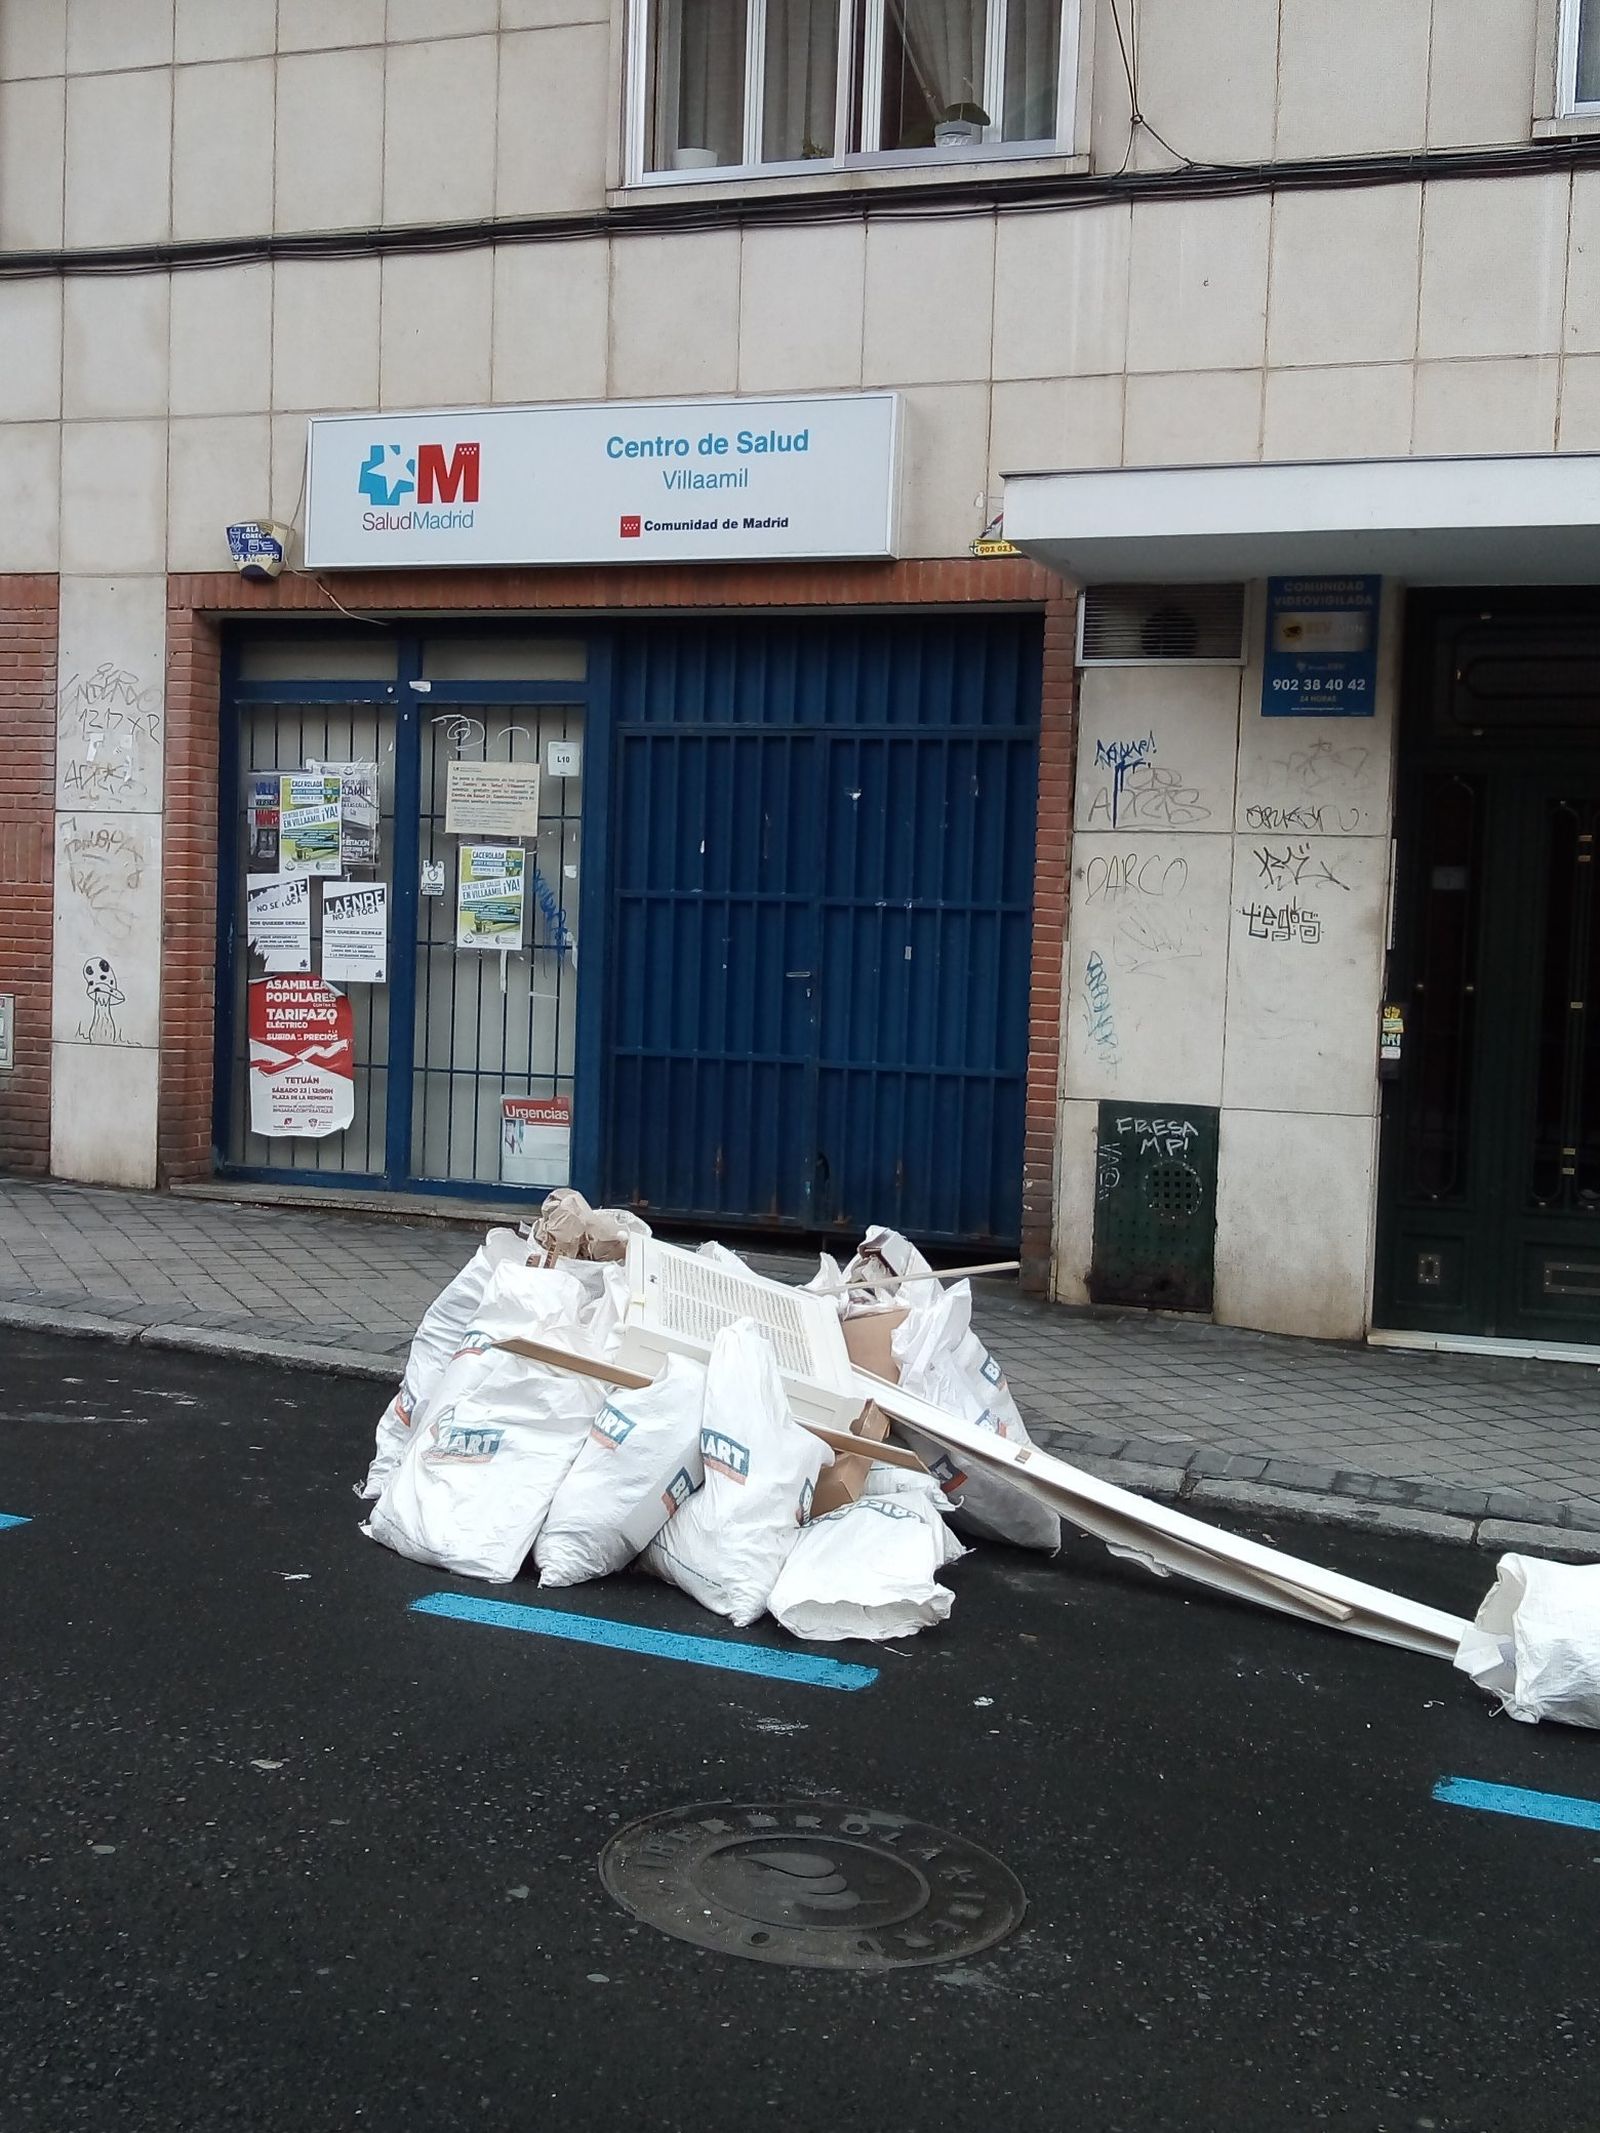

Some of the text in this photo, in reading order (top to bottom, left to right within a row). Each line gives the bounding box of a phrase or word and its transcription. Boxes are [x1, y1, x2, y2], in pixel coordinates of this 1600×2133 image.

[606, 429, 809, 459] Centro de Salud
[662, 468, 749, 490] Villaamil
[362, 510, 474, 531] SaludMadrid
[644, 517, 789, 531] Comunidad de Madrid
[1284, 581, 1365, 592] COMUNIDAD
[1274, 595, 1373, 606] VIDEOVIGILADA
[1272, 679, 1366, 691] 902 38 40 42
[283, 819, 292, 828] EN
[321, 806, 338, 822] ¡YA!
[462, 879, 520, 900] EN VILLAAMIL ¡YA!
[256, 904, 268, 912] NO
[270, 902, 279, 910] SE
[332, 906, 379, 921] NO SE TOCA
[266, 980, 329, 990] ASAMBLEA
[266, 992, 336, 1002] POPULARES
[266, 1008, 338, 1025] TARIFAZO
[303, 1033, 338, 1041] PRECIOS
[285, 1075, 320, 1084] TETUÁN
[505, 1105, 569, 1120] Urgencias
[1116, 1117, 1199, 1138] FRESA
